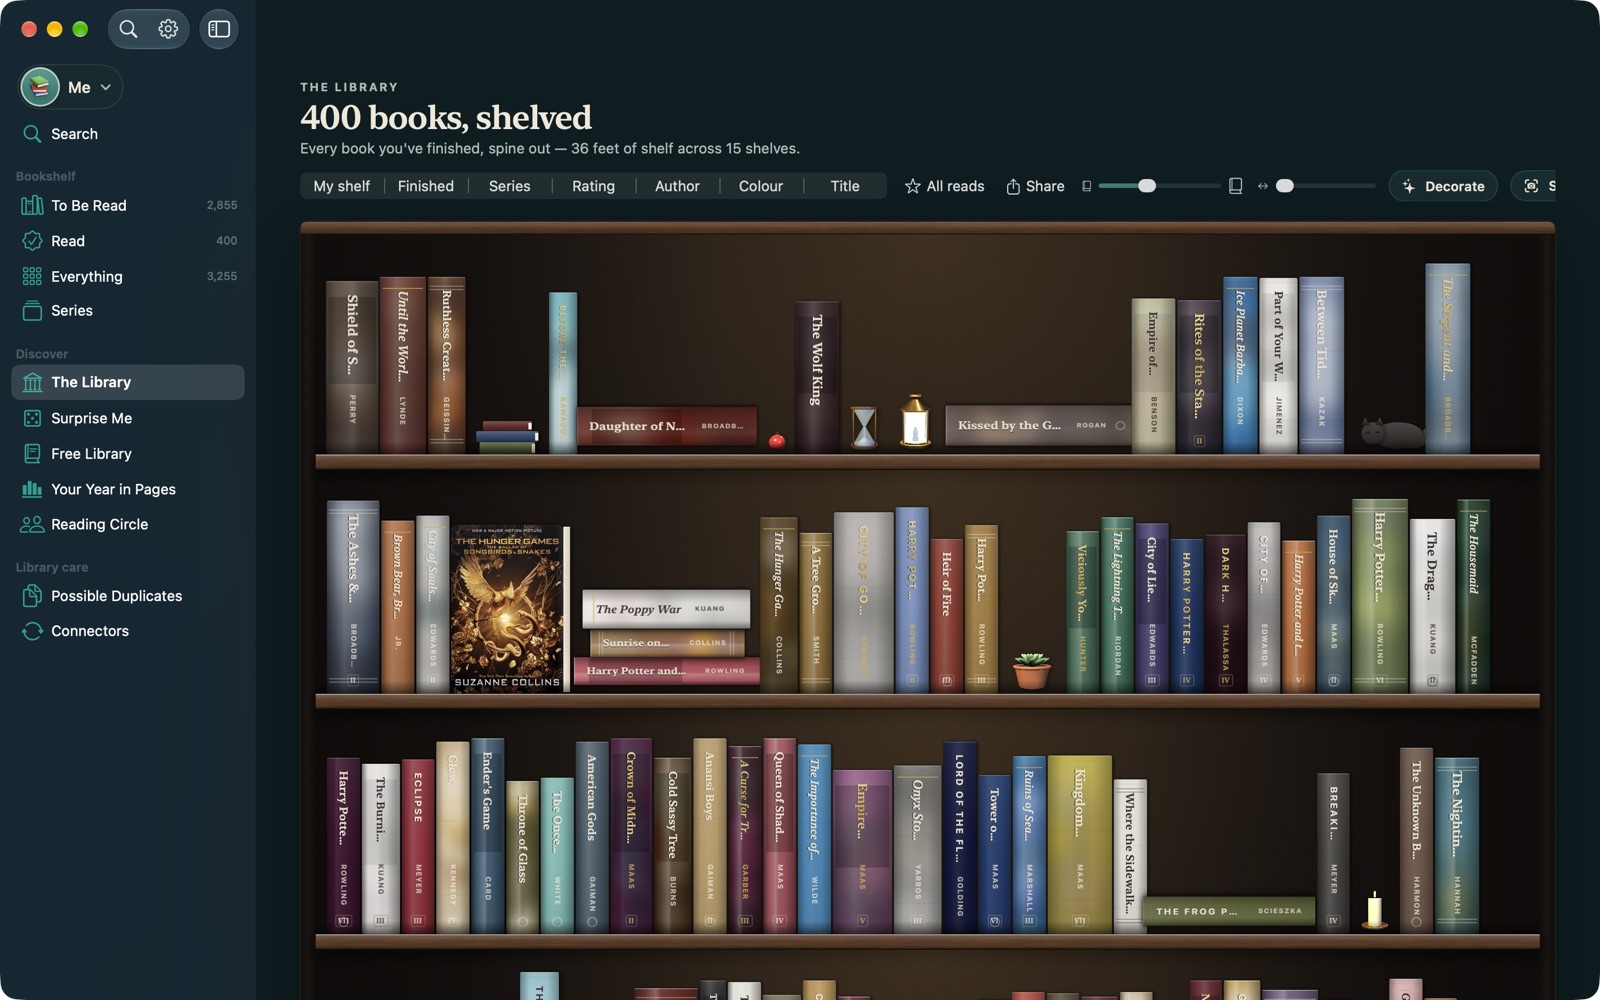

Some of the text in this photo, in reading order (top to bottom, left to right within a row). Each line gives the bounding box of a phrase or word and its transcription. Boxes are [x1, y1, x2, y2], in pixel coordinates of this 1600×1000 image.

[69, 81, 90, 93] Me
[300, 82, 397, 93] THE LIBRARY
[301, 104, 592, 134] 400 books, shelved
[52, 128, 97, 139] Search
[301, 142, 799, 156] Every book you've finished, spine out 36 feet of shelf across 15 shelves.
[16, 171, 76, 181] Bookshelf
[314, 180, 370, 194] My shelf
[399, 180, 453, 192] Finished
[490, 180, 530, 192] Series
[573, 180, 614, 194] Rating
[655, 180, 700, 192] Author
[739, 180, 783, 192] Colour
[831, 180, 859, 192] Title
[927, 180, 984, 192] All reads
[1027, 180, 1064, 192] Share
[1426, 181, 1485, 192] Decorate
[52, 200, 126, 211] To Be Read
[207, 200, 237, 211] 2,855
[52, 235, 84, 247] Read
[217, 235, 237, 246] 400
[52, 271, 122, 285] Everything
[207, 272, 237, 282] 3,255
[52, 304, 93, 316] Series
[398, 292, 408, 320] Until
[347, 295, 358, 336] Shield
[442, 290, 452, 339] Ruthless
[398, 323, 408, 342] the
[1147, 312, 1158, 352] Empire
[1195, 314, 1205, 345] Rites
[16, 349, 68, 359] Discover
[348, 340, 358, 354] of
[810, 315, 823, 406] The Wolf King
[1194, 349, 1205, 362] of
[1194, 365, 1205, 385] the
[52, 376, 131, 390] The Library
[349, 395, 357, 423] PERRY
[399, 397, 407, 424] LYNDE
[1150, 397, 1158, 432] BENSON
[1236, 397, 1244, 424] DIXON
[52, 412, 132, 426] Surprise Me
[590, 422, 647, 433] Daughter
[651, 421, 663, 431] of
[52, 448, 132, 462] Free Library
[52, 483, 176, 497] Your Year in Pages
[52, 518, 148, 532] Reading Circle
[478, 537, 521, 545] HUNGER
[1427, 532, 1437, 556] The
[1469, 514, 1479, 594] The Housemaid
[16, 562, 88, 574] Library care
[1221, 548, 1230, 579] DARK
[1182, 553, 1191, 592] HARRY
[942, 552, 952, 616] Heir of Fire
[52, 590, 182, 604] Possible Duplicates
[597, 604, 681, 616] The Poppy War
[52, 625, 129, 636] Connectors
[1429, 624, 1437, 654] KUANG
[1222, 624, 1230, 671] THALASSA
[1470, 636, 1478, 684] MCFADDEN
[455, 678, 559, 687] SUZANNE COLLINS
[955, 755, 964, 785] LORD
[337, 771, 348, 804] Harry
[1452, 771, 1462, 795] The
[413, 773, 423, 822] ECLIPSE
[482, 752, 493, 830] Ender's Game
[587, 754, 597, 841] American Gods
[955, 791, 964, 806] OF
[666, 771, 678, 858] Cold Sassy Tree
[1125, 793, 1135, 830] Where
[955, 811, 964, 833] THE
[1125, 834, 1135, 851] the
[340, 865, 348, 905] ROWLING
[415, 865, 423, 893] MEYER
[1330, 865, 1338, 893] MEYER
[483, 876, 492, 900] CARD
[589, 877, 597, 911] GAIMAN
[669, 877, 677, 906] BURNS
[956, 877, 964, 916] GOLDING
[1157, 907, 1178, 916] THE
[1185, 907, 1215, 916] FROG
[1258, 907, 1302, 915] SCIESZKA
